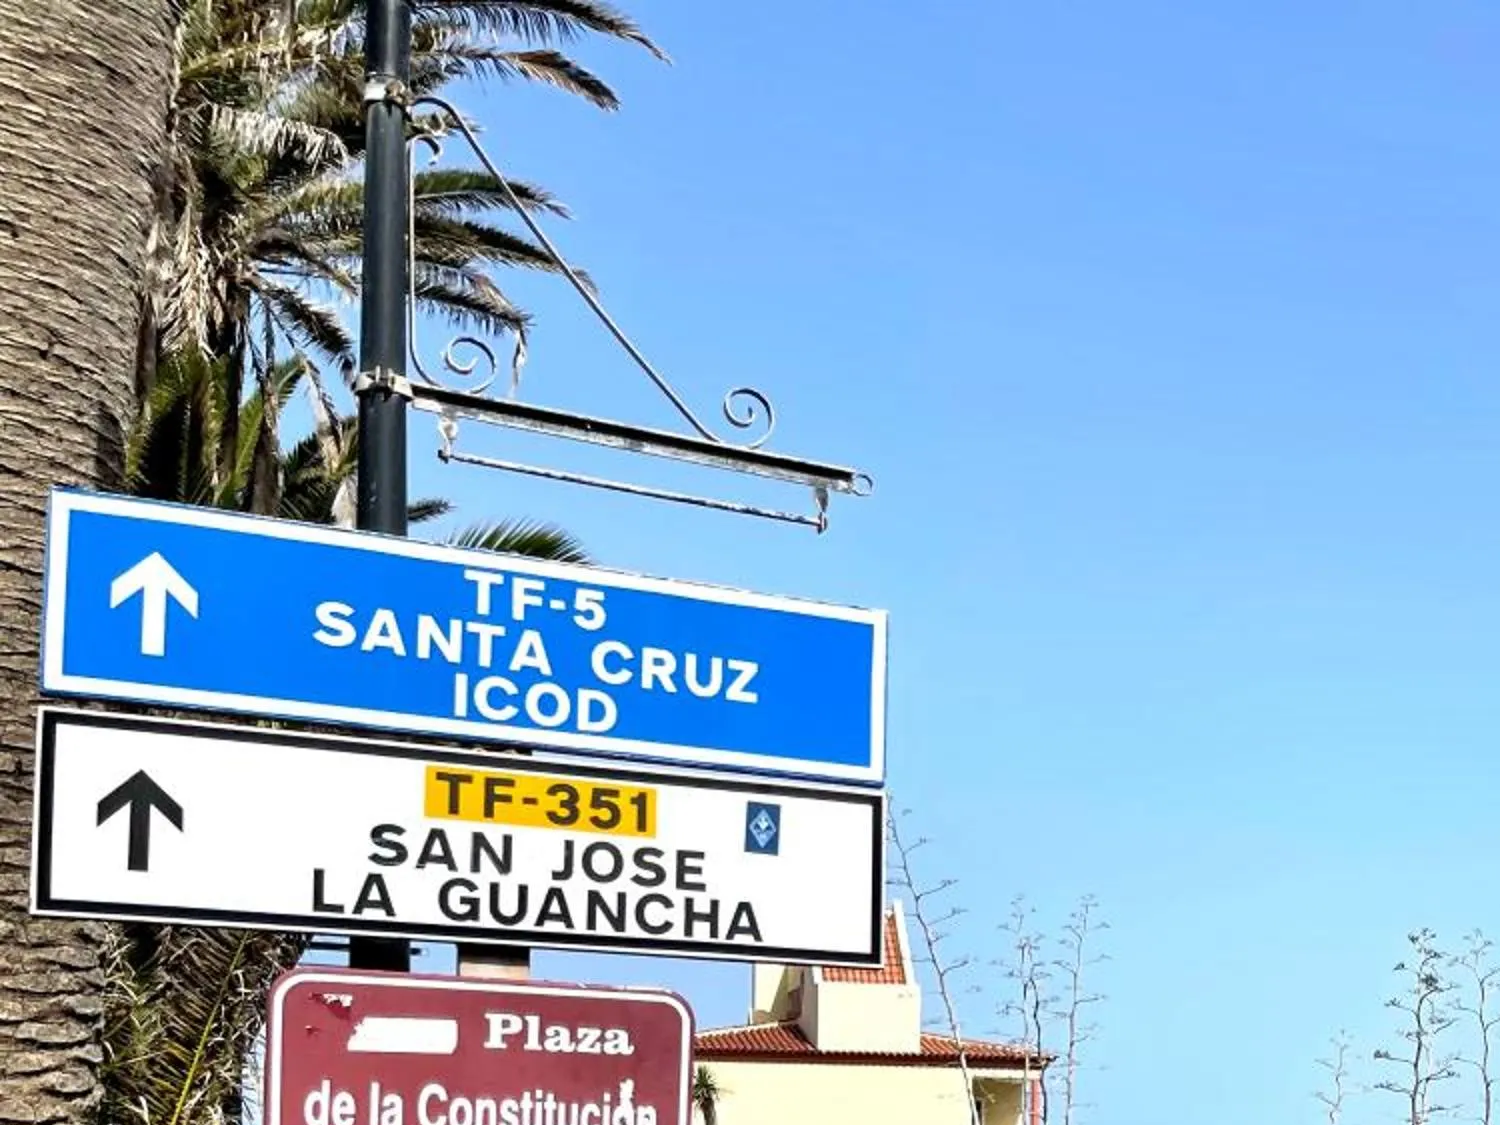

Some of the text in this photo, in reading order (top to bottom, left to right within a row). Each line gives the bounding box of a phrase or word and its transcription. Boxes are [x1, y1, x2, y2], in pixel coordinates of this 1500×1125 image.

[464, 569, 607, 631] TF-5
[313, 601, 760, 703] SANTA CRUZ
[454, 673, 618, 733] ICOD
[436, 772, 649, 833] TF-351
[368, 823, 707, 892] SAN JOSE
[312, 868, 763, 943] LA GUANCHA
[484, 1012, 635, 1056] Plaza
